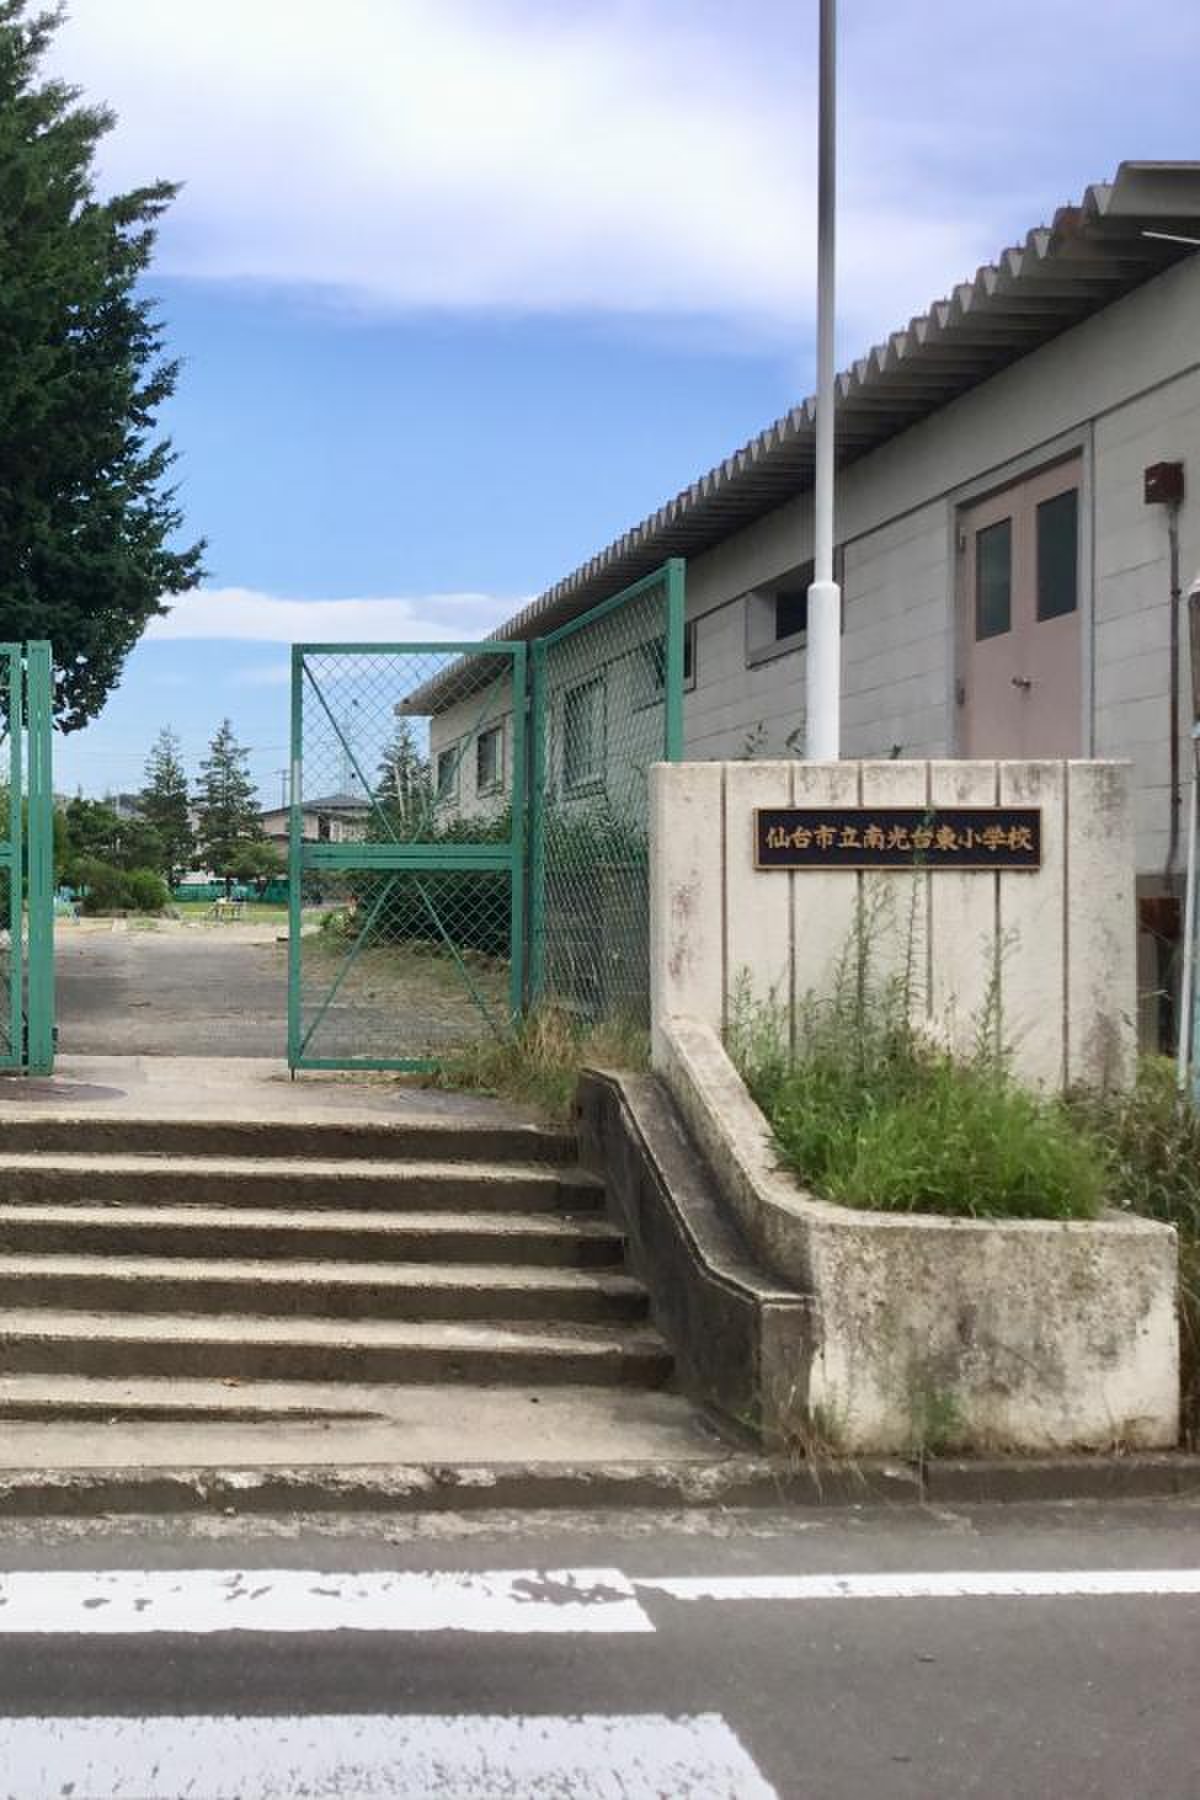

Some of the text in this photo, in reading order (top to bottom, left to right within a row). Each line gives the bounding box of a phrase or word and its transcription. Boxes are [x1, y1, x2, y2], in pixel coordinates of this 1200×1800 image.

[766, 825, 1035, 851] 仙台市立南光台東小学校
